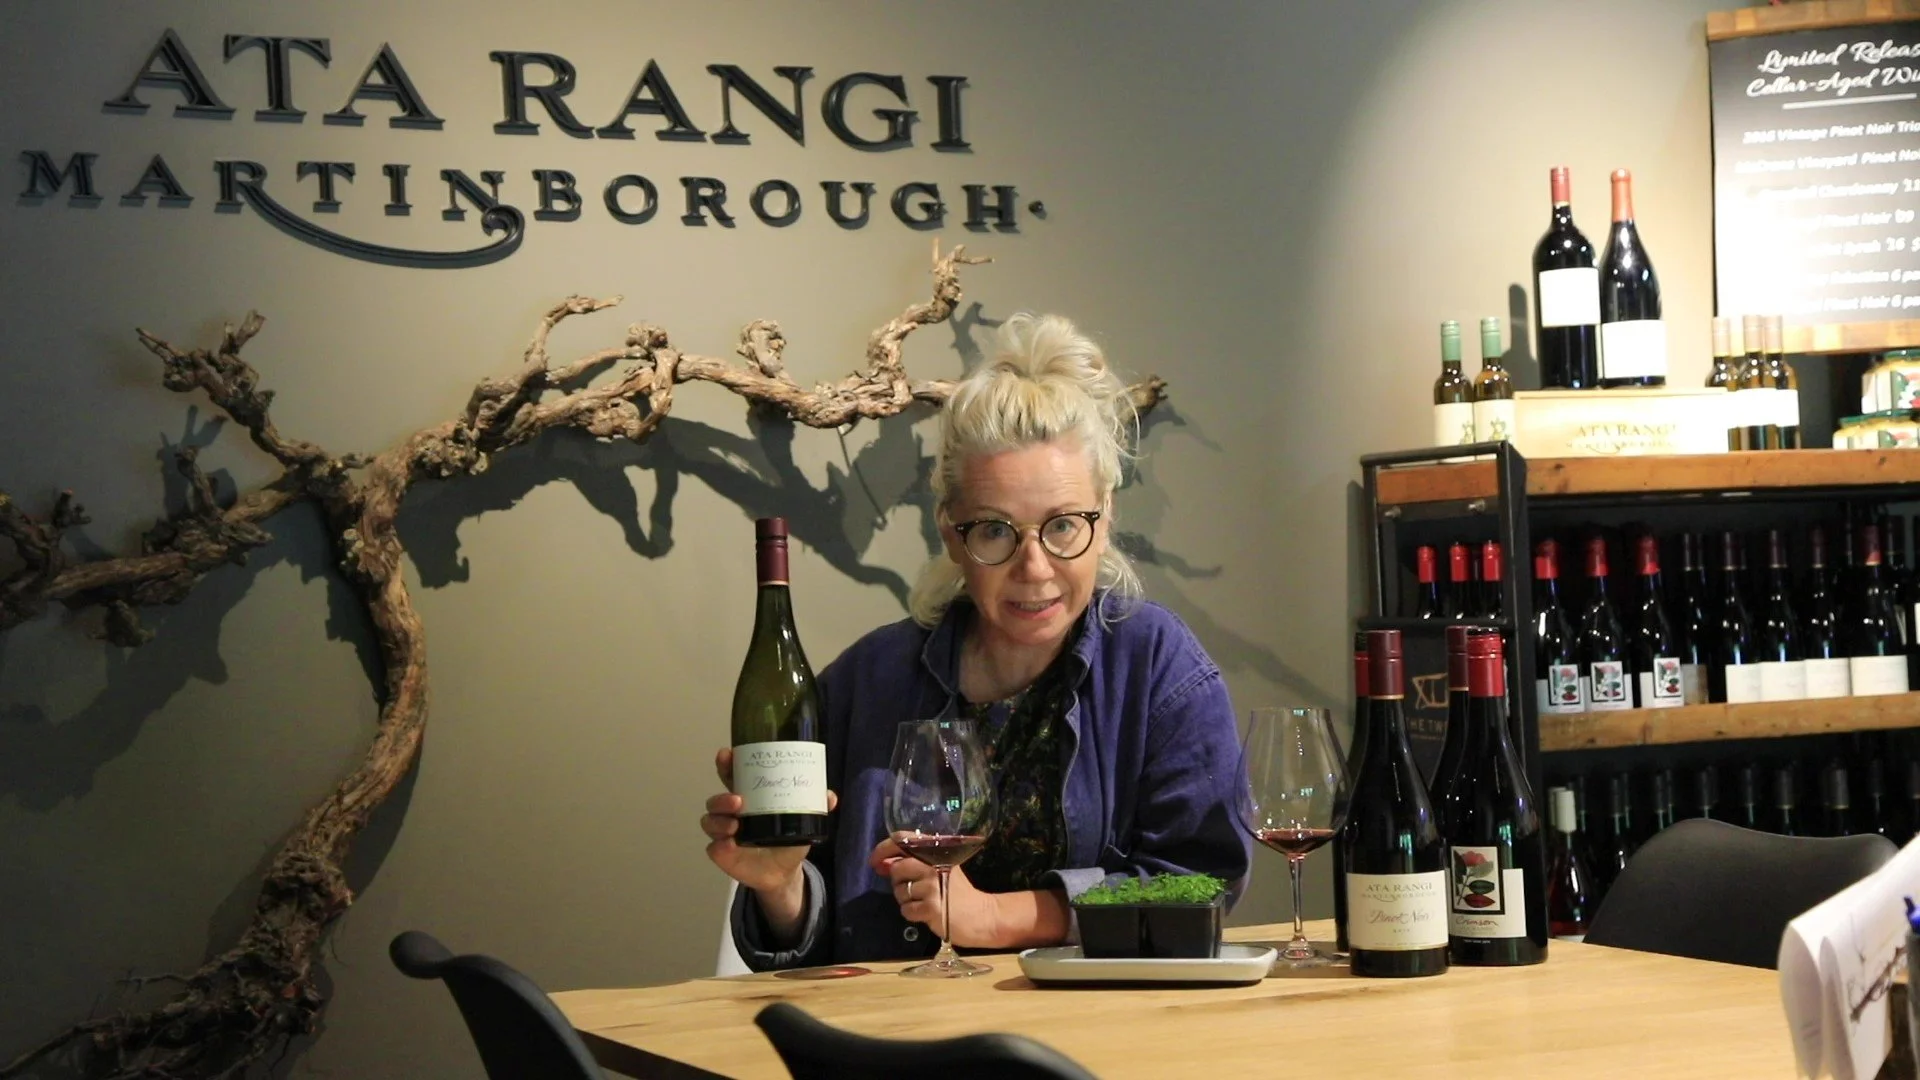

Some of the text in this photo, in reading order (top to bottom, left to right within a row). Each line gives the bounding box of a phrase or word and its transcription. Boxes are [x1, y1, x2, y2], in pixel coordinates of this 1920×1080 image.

[1757, 43, 1848, 74] Limited
[103, 28, 972, 154] ATA RANGI
[1829, 125, 1864, 138] Pinot
[1865, 122, 1896, 135] Noir
[1861, 150, 1897, 164] Pinot
[750, 750, 813, 760] ATA RANGI
[1366, 882, 1433, 892] ATA RANGI
[1455, 916, 1499, 927] Crimson
